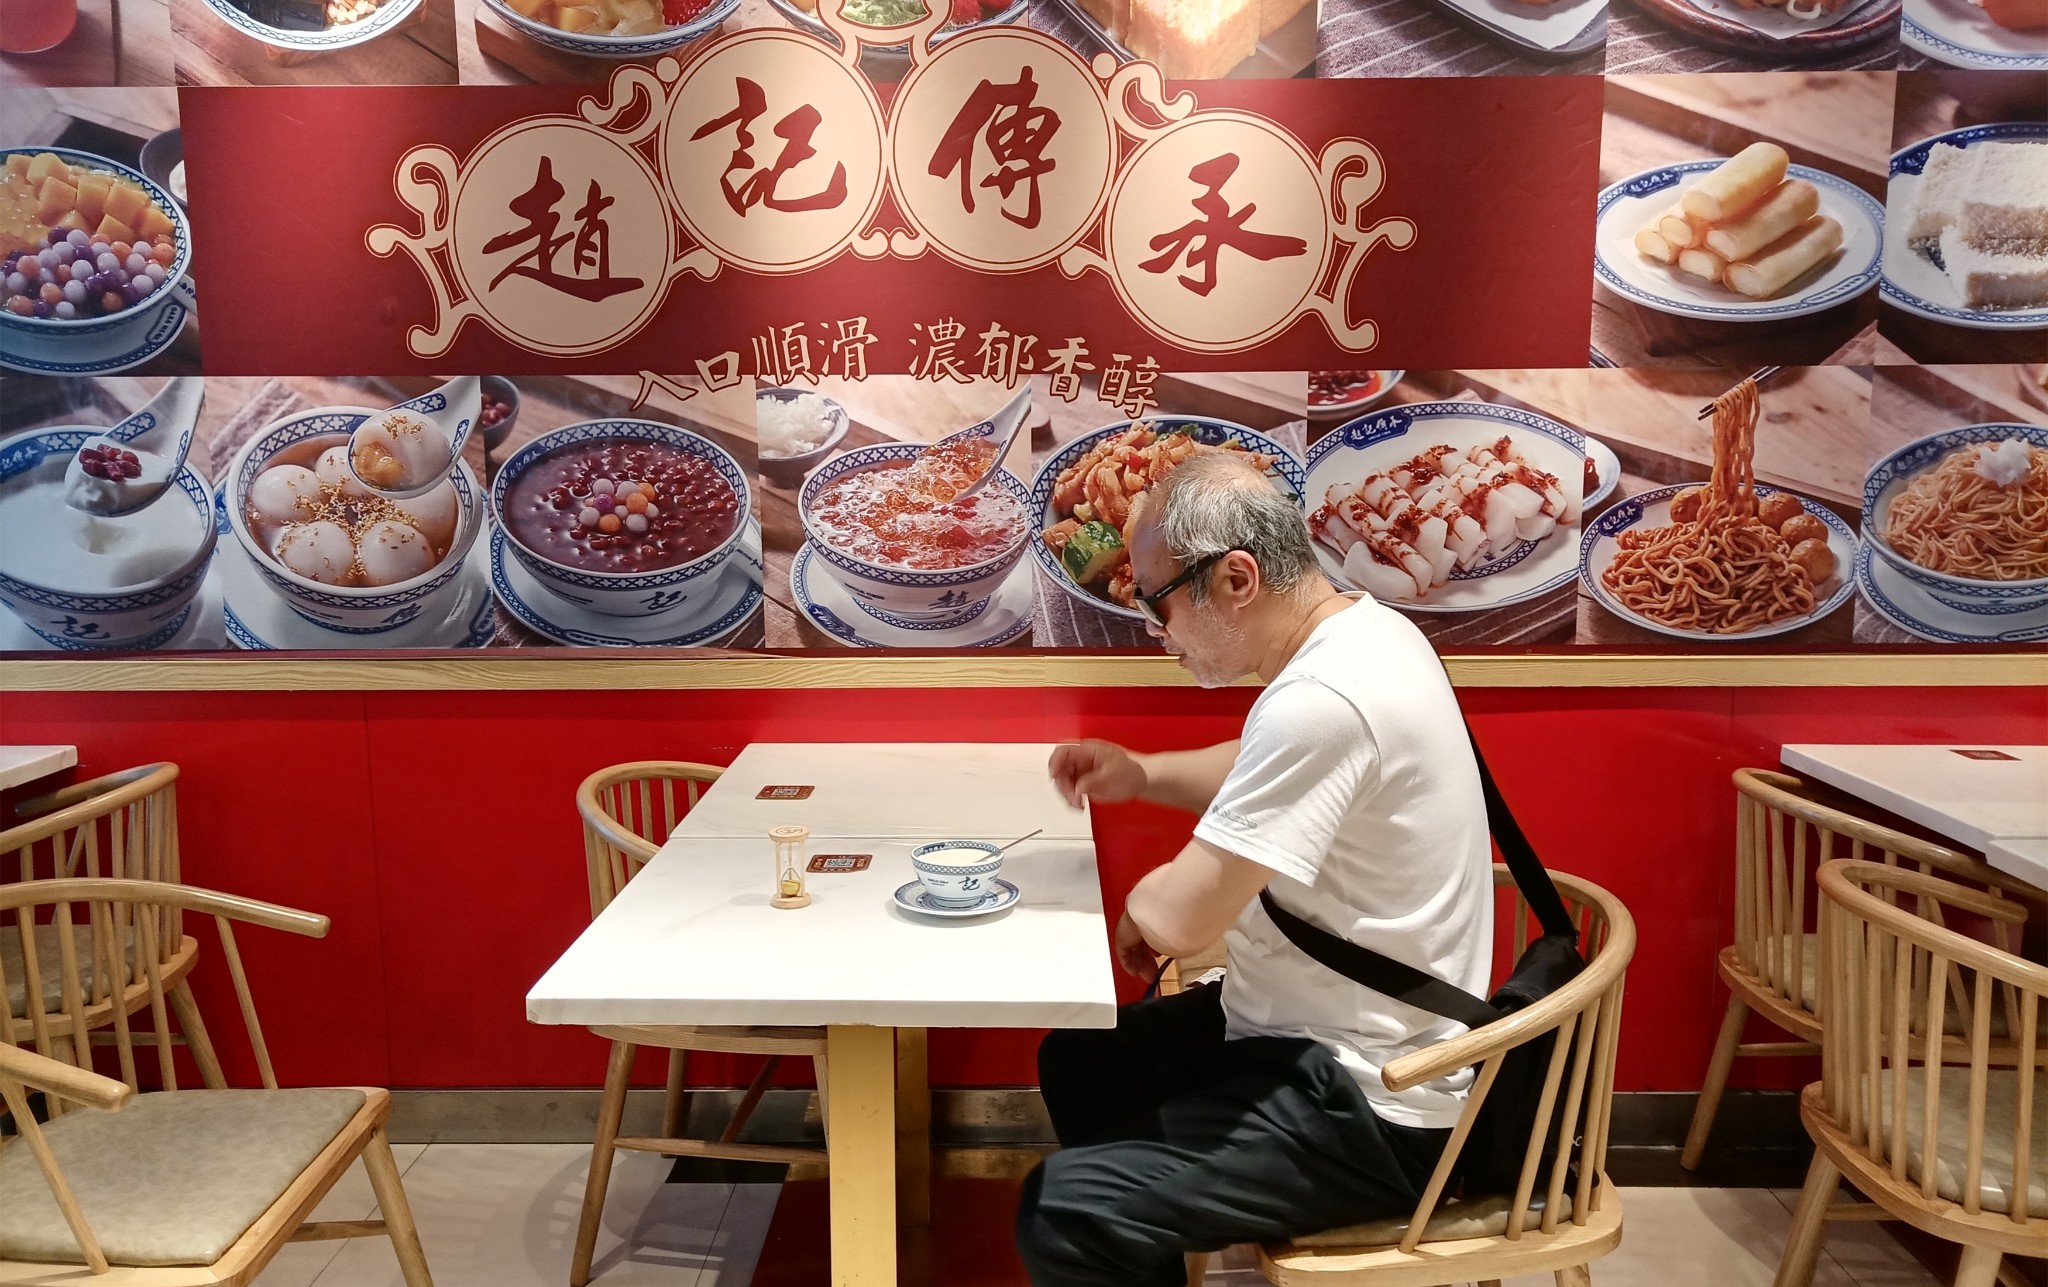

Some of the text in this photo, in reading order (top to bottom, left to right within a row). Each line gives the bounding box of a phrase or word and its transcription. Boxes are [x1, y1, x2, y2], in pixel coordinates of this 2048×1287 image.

[482, 65, 1307, 303] 趙記傳承
[629, 315, 1161, 419] 入口順滑 濃郁香醇
